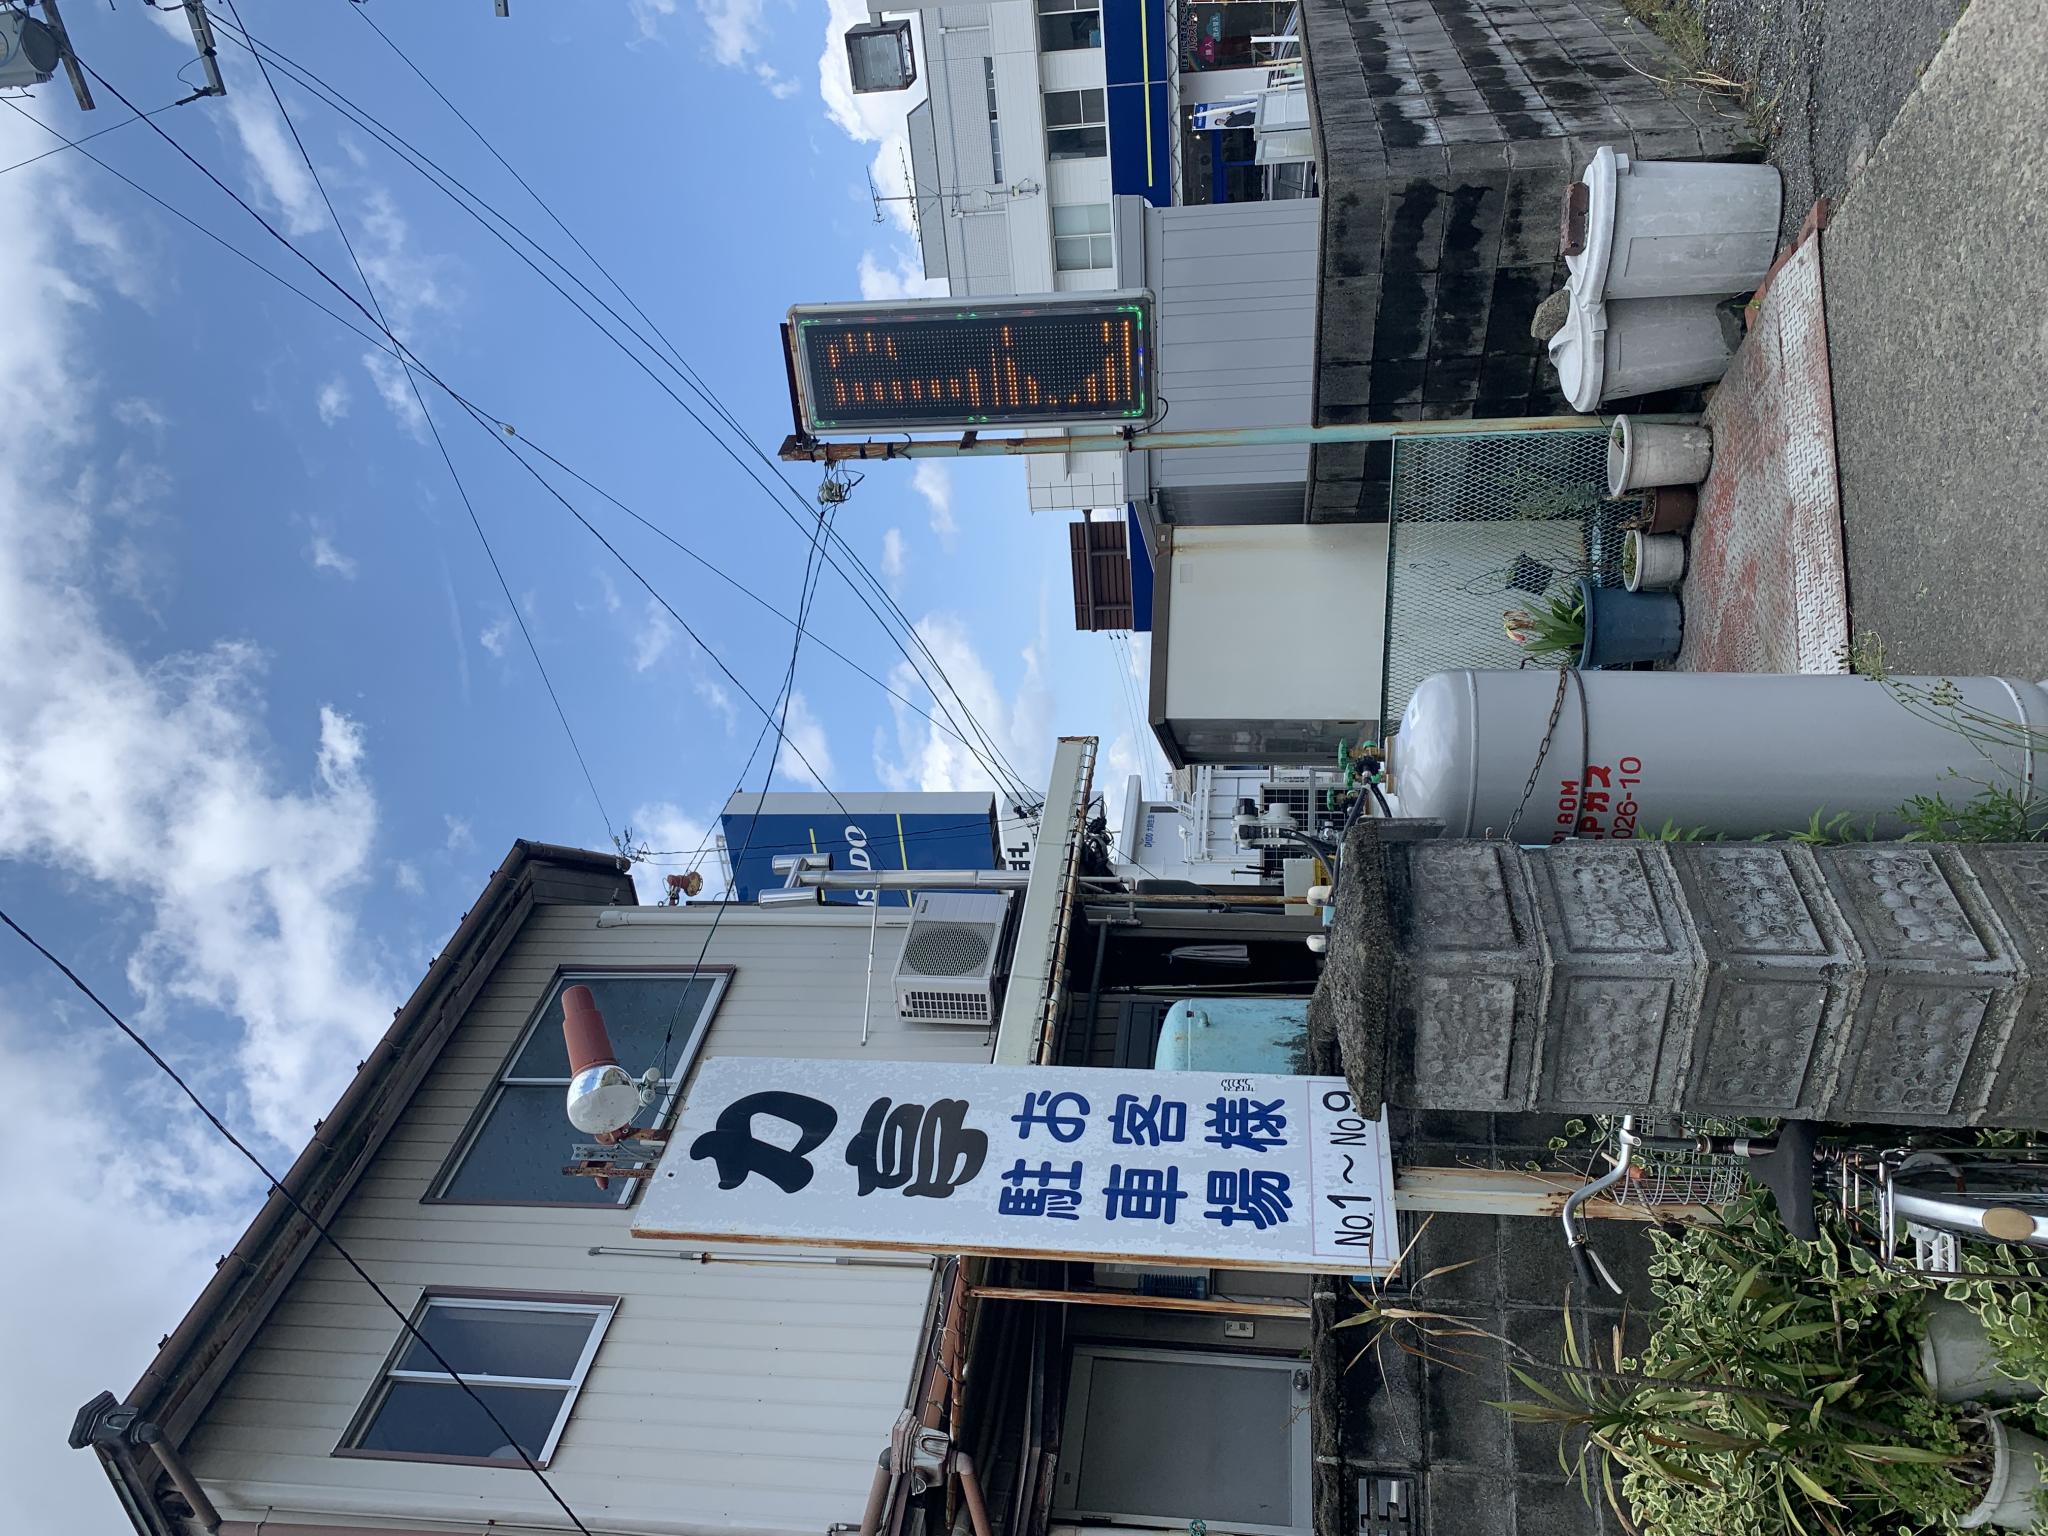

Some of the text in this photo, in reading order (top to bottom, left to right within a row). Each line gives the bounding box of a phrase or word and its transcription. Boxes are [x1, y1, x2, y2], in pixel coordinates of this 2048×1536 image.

[1578, 766, 1612, 840] Pガス
[1010, 1091, 1288, 1153] お客様
[998, 1158, 1294, 1230] 駐車場
